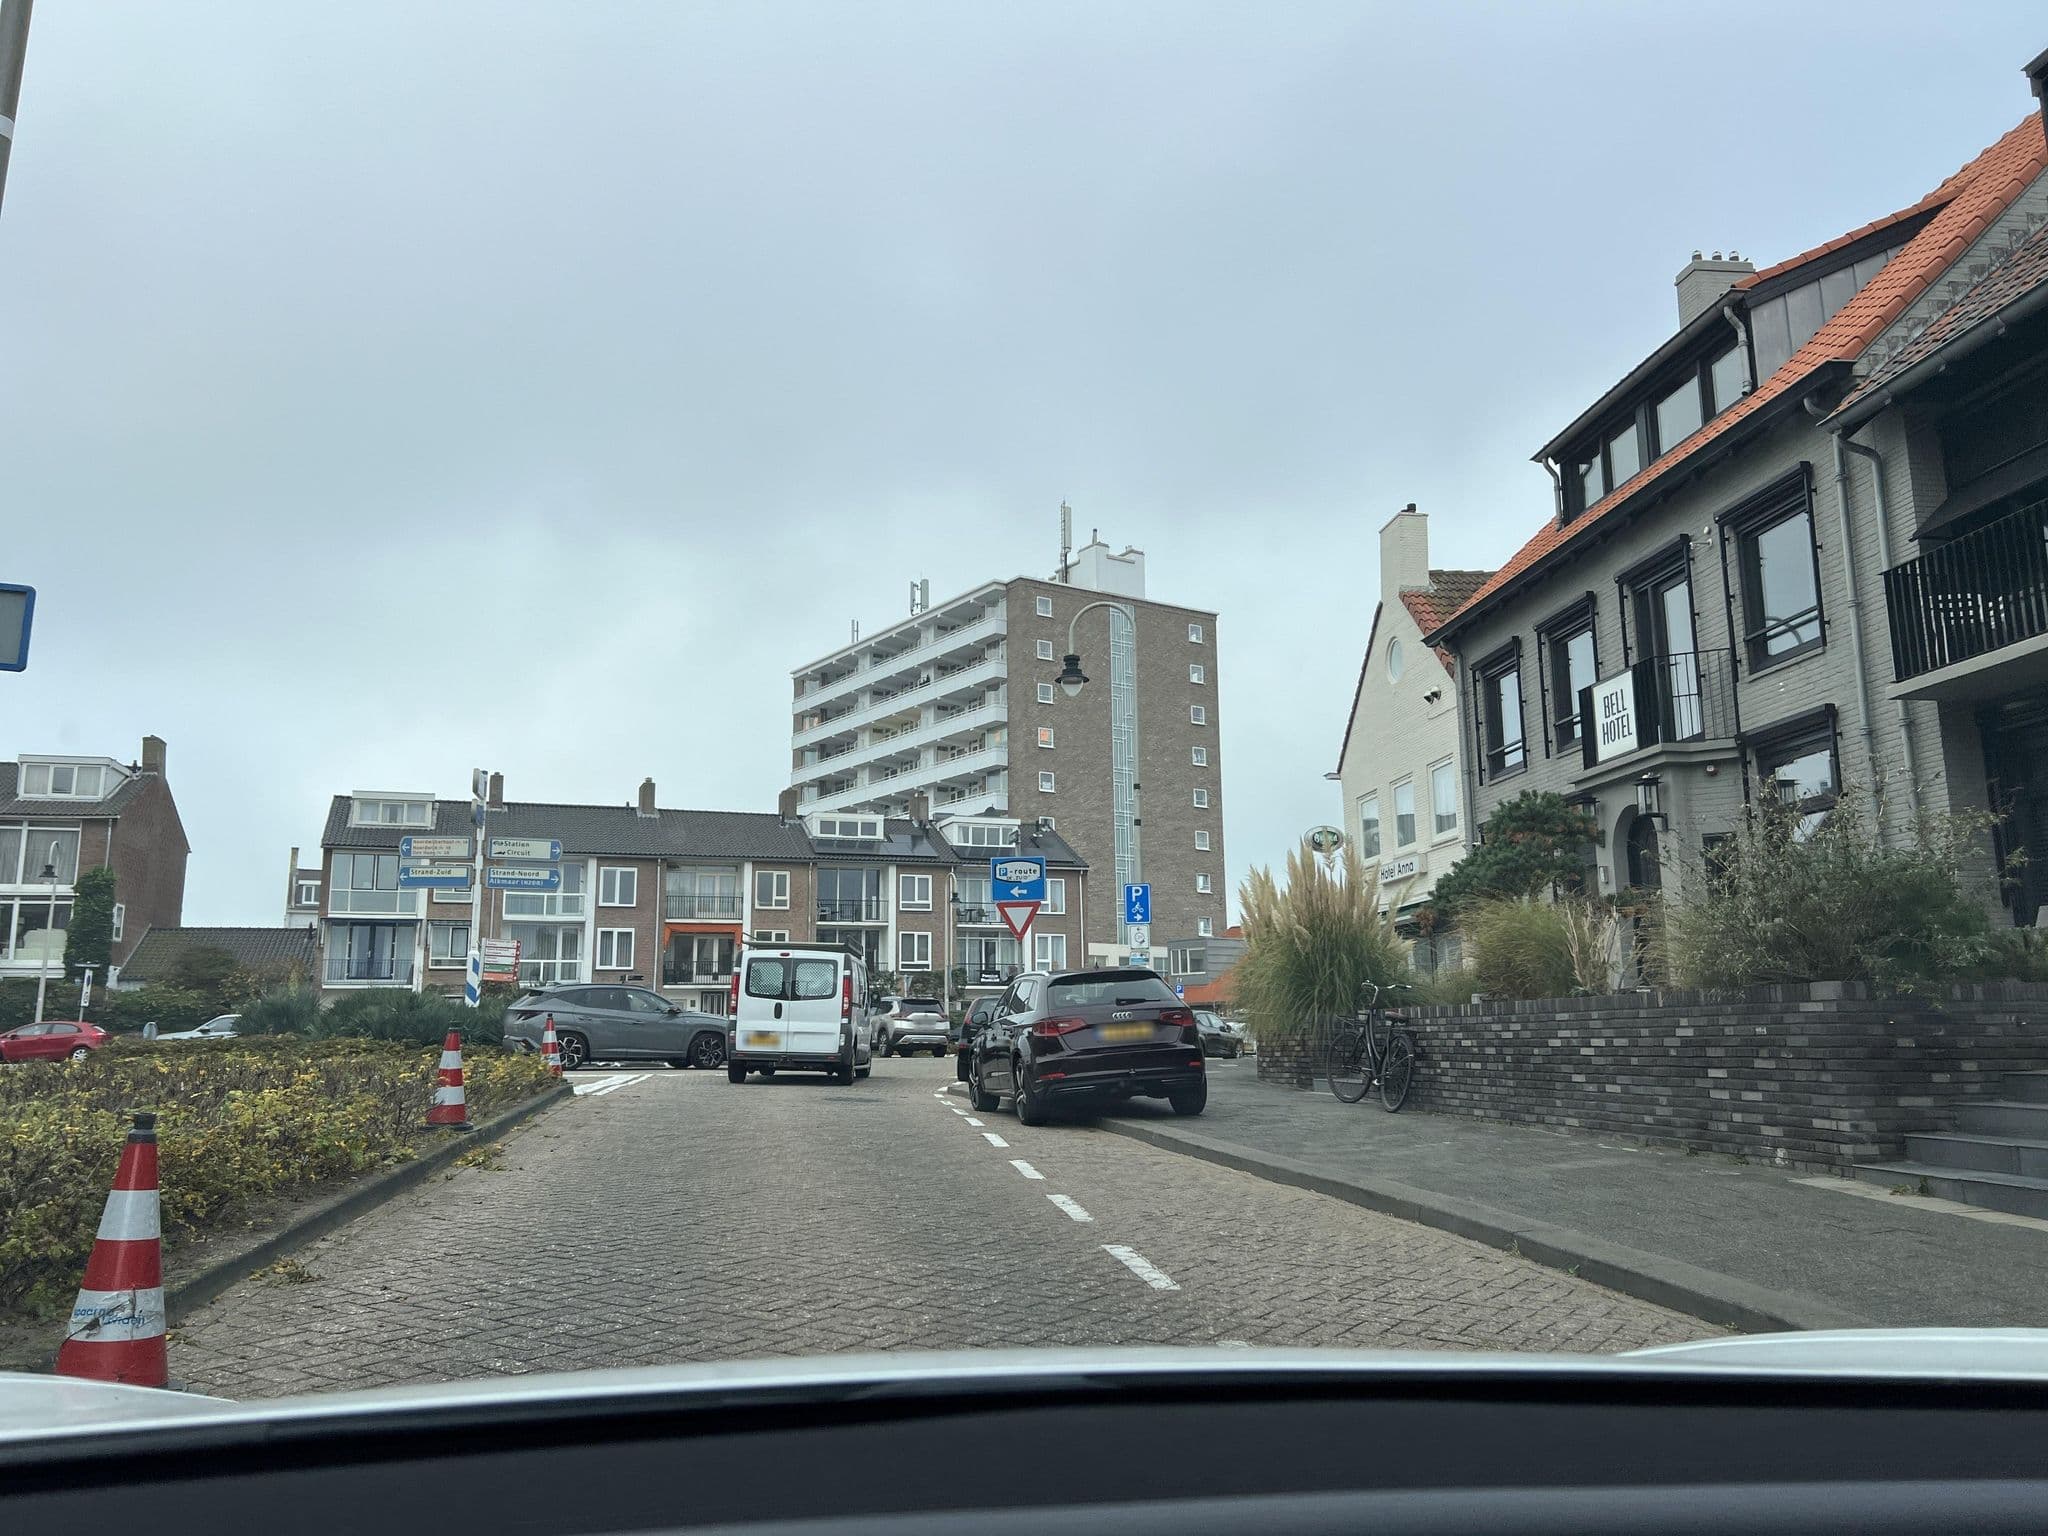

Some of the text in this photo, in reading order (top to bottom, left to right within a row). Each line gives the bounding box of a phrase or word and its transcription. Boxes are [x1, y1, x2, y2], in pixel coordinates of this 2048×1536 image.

[1603, 688, 1627, 719] BELL
[1602, 713, 1632, 746] HOTEL
[491, 869, 540, 877] Strand-Noord
[1380, 861, 1414, 881] Hotel Anna
[1132, 886, 1143, 902] P
